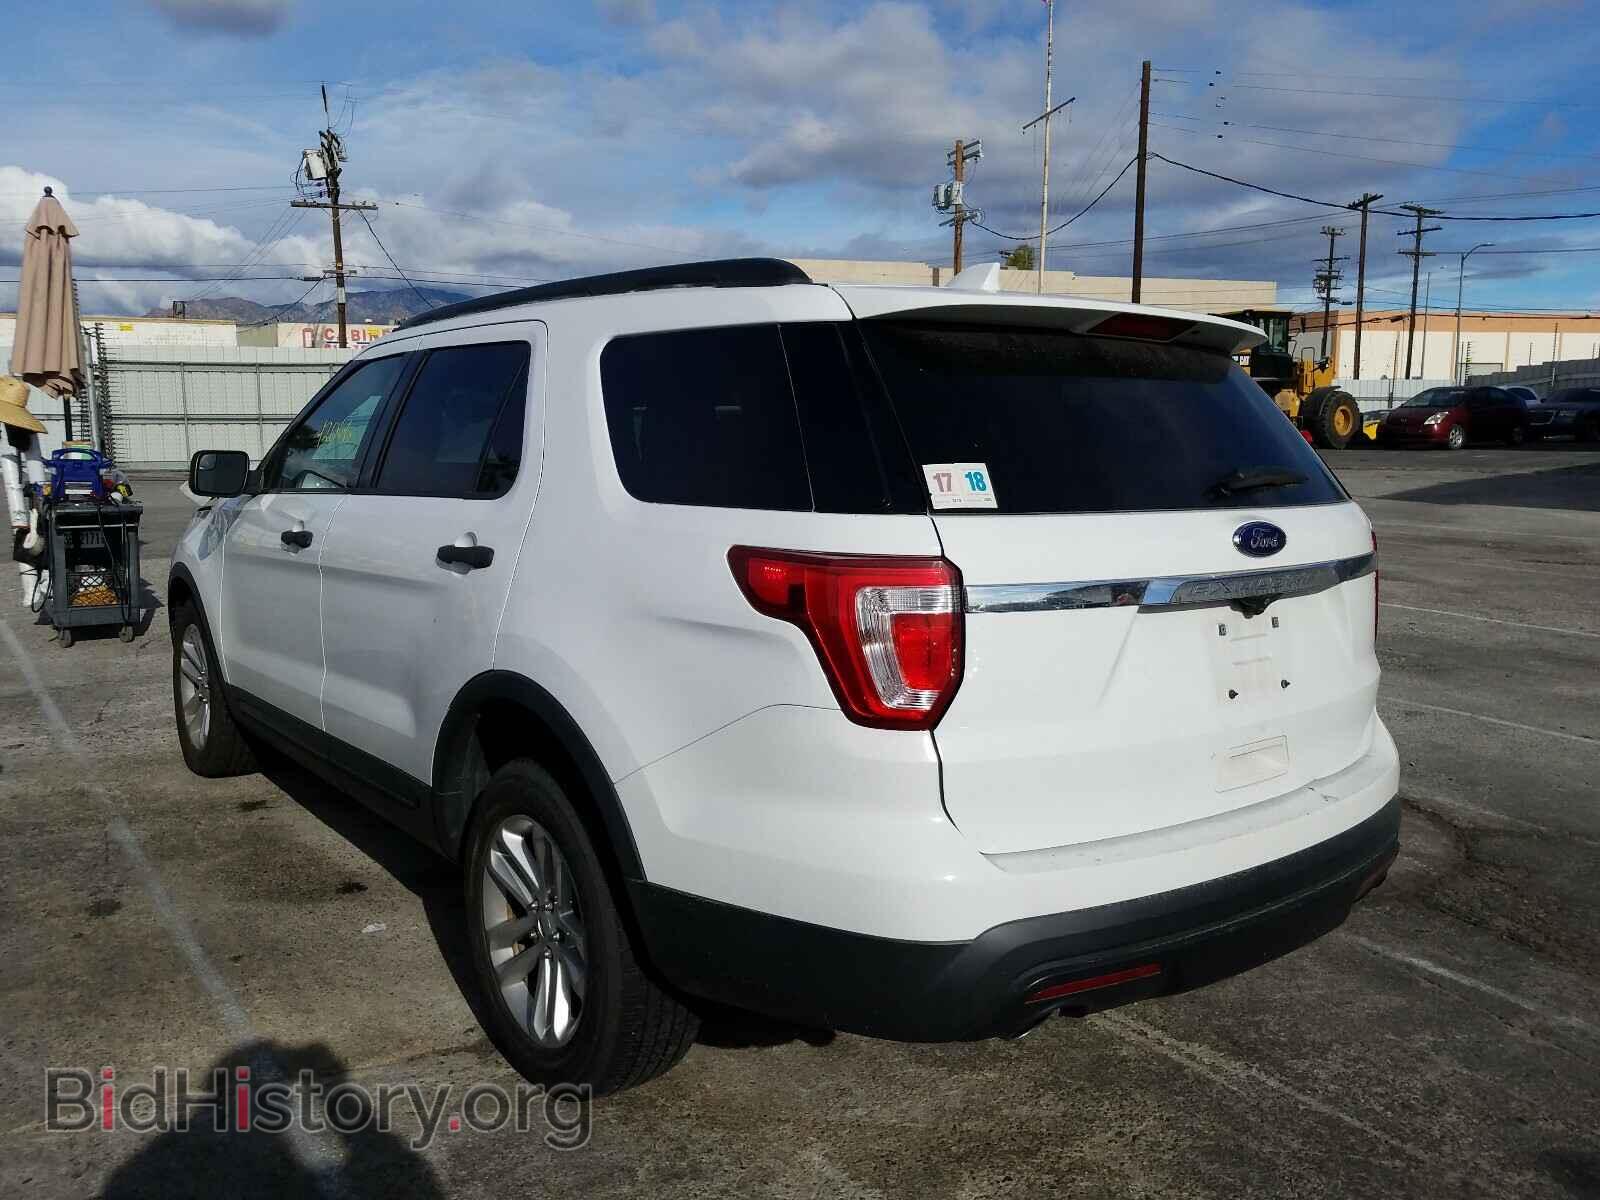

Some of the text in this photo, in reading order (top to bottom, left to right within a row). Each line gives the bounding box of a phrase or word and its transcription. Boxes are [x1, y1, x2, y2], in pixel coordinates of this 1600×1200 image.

[932, 471, 987, 493] 17 18
[1250, 527, 1279, 549] Ford
